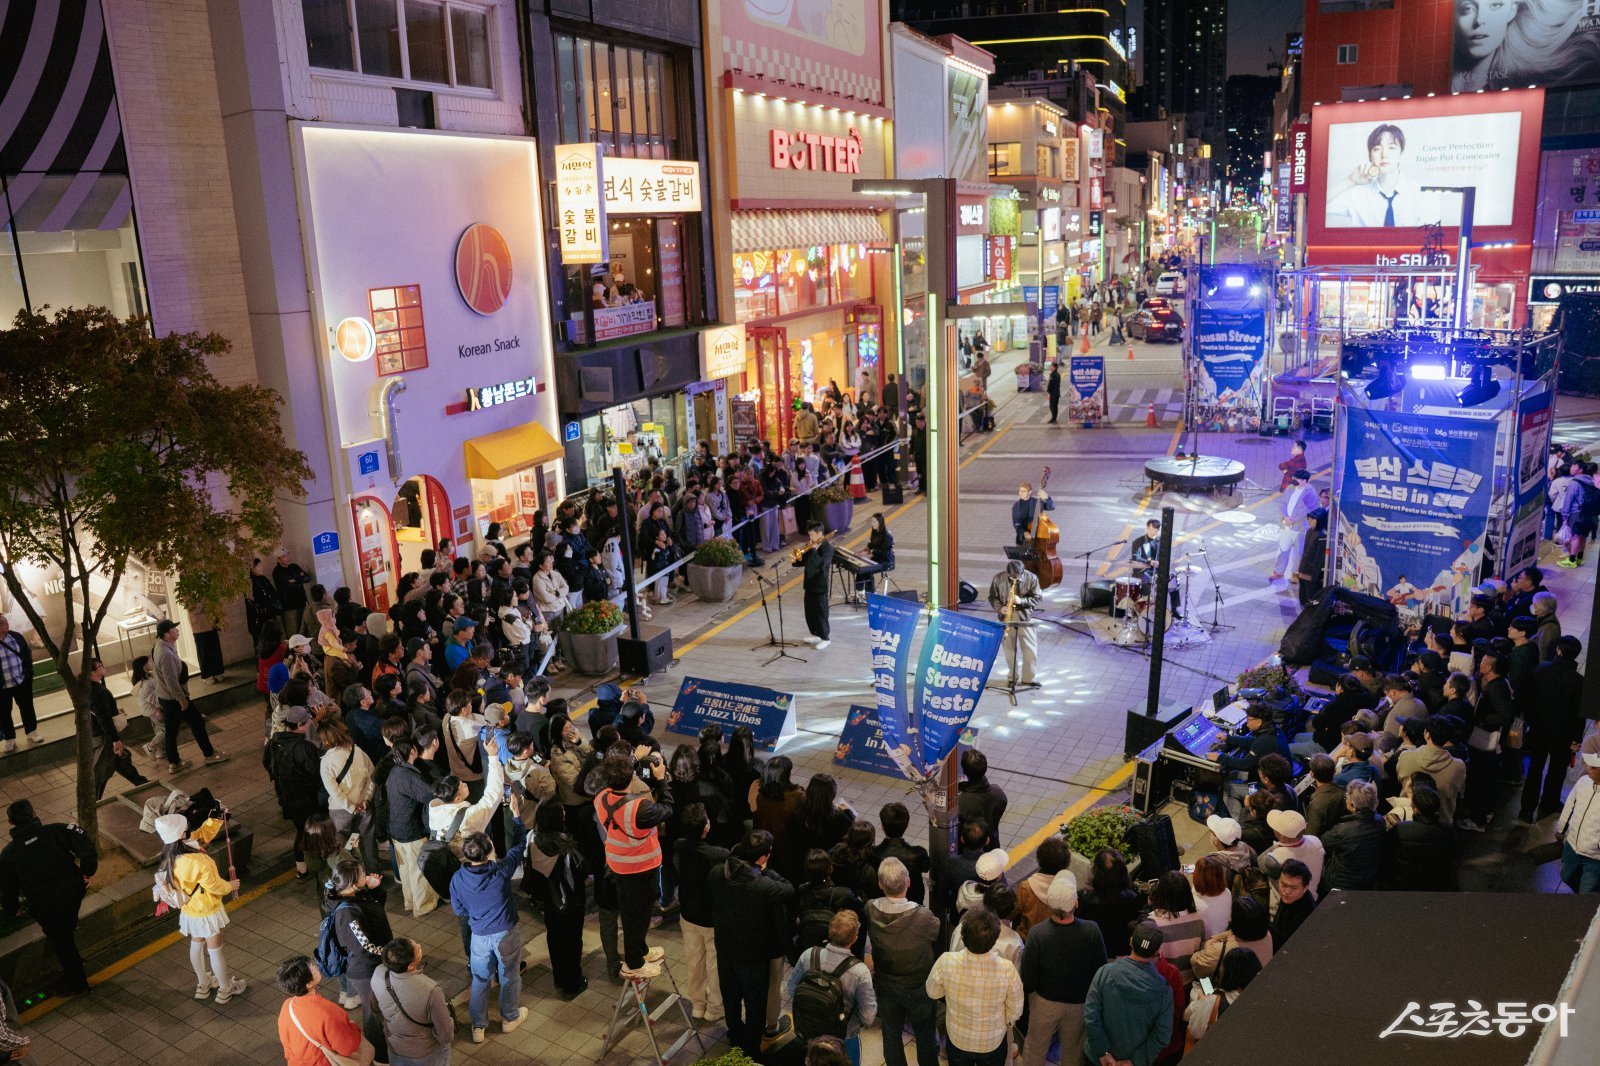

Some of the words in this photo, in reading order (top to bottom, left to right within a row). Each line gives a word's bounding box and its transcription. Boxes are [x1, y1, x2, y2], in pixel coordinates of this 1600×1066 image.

[1295, 131, 1307, 149] the
[1422, 144, 1447, 152] Cover
[1448, 142, 1494, 151] Perfection
[1415, 155, 1438, 165] Triple
[1439, 154, 1455, 162] Pot
[1455, 151, 1501, 161] Concealer
[604, 176, 633, 202] 면식
[640, 177, 694, 202] 숯불갈비
[564, 208, 595, 225] 숯불
[565, 228, 597, 244] 갈비
[1376, 253, 1398, 267] the
[1229, 330, 1261, 342] Street
[459, 342, 492, 358] Korean
[494, 336, 521, 351] Snack
[481, 377, 537, 407] 황남쫀드기
[365, 455, 373, 463] 60
[1354, 456, 1402, 482] 부산
[1407, 459, 1483, 494] 스트릿
[1360, 482, 1408, 502] 페스타
[1411, 488, 1429, 505] in
[1361, 500, 1380, 508] Busan
[1380, 502, 1401, 512] Street
[1401, 505, 1420, 514] Festa
[1427, 509, 1463, 520] Gwangbok
[320, 534, 331, 543] 62
[873, 654, 896, 672] 트릿
[931, 643, 984, 673] Busan
[925, 666, 980, 692] Street
[923, 686, 975, 712] Festa
[694, 705, 705, 714] in
[706, 709, 730, 720] Jazz
[926, 711, 969, 727] Gwangbok
[864, 737, 878, 748] in
